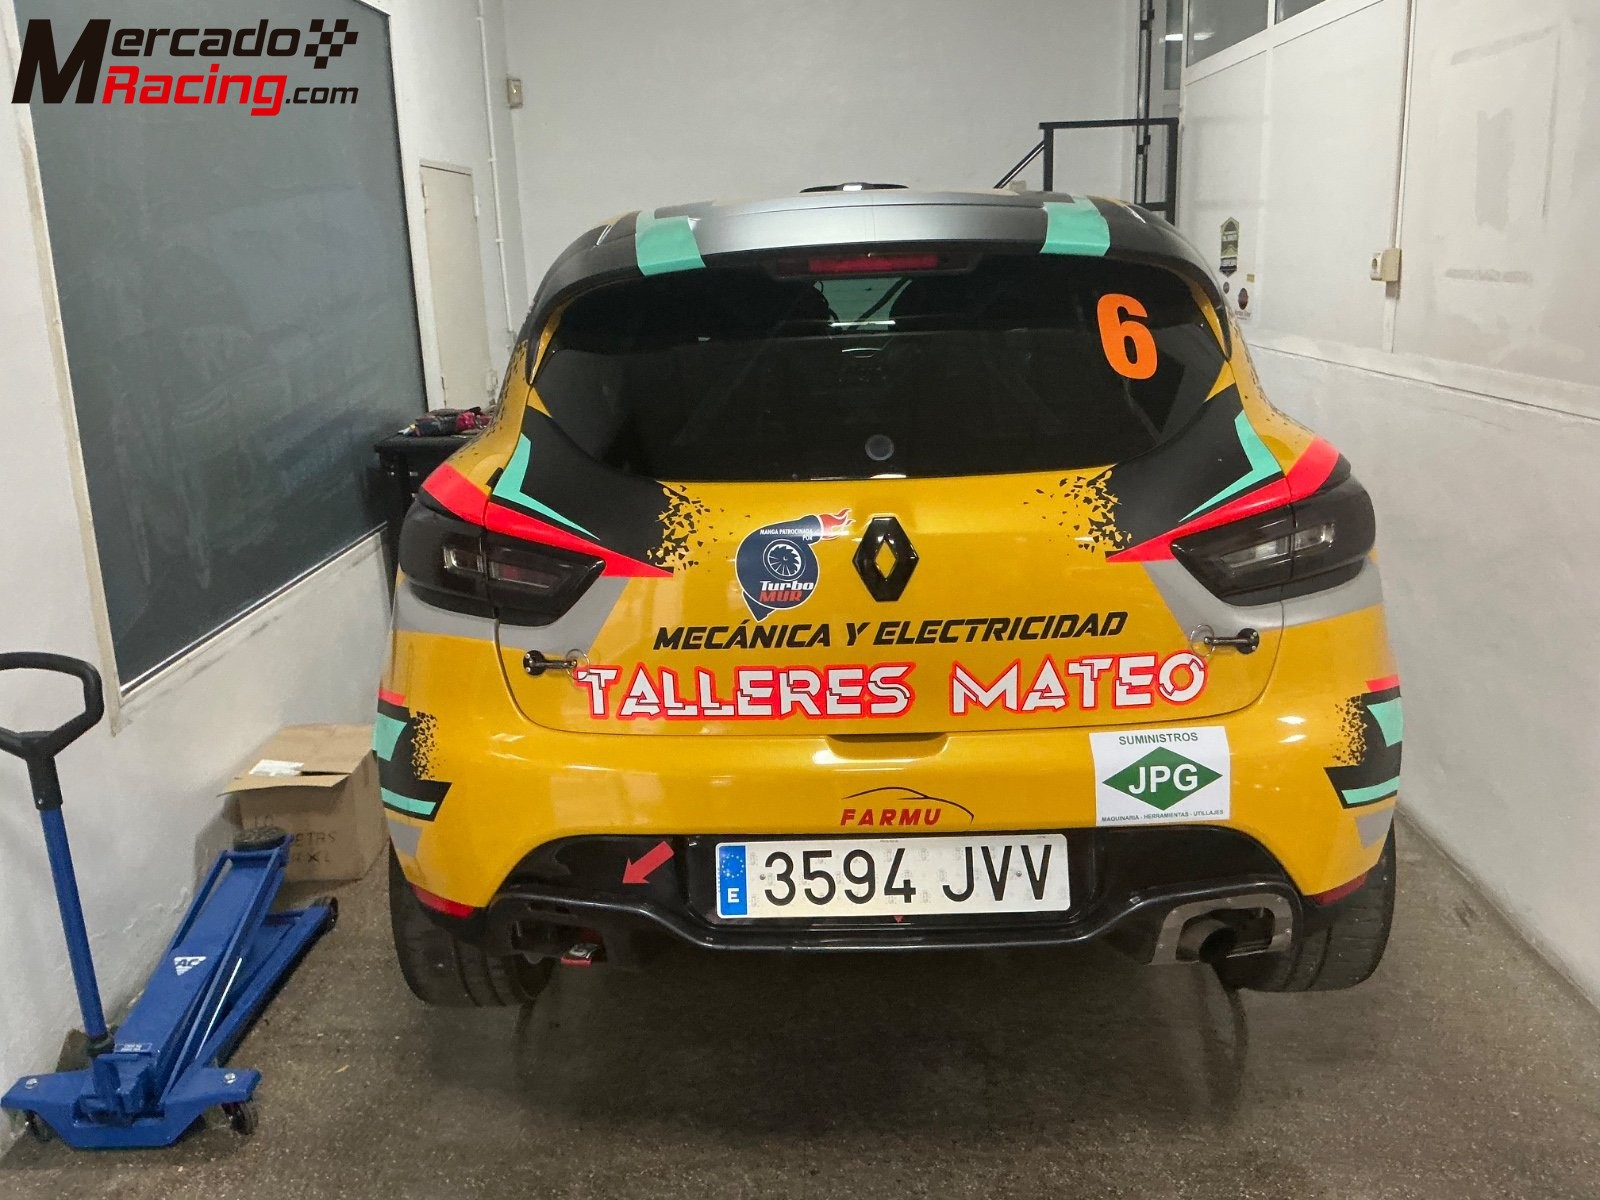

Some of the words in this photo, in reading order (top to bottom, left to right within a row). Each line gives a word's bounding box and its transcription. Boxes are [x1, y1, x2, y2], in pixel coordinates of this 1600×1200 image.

[1097, 293, 1158, 380] 6
[760, 580, 814, 591] Turbo
[759, 591, 803, 602] MUR
[653, 620, 831, 651] MECÁNICA
[846, 622, 871, 646] Y
[873, 611, 1128, 645] ELECTRICIDAD
[575, 662, 917, 721] TALLERES
[950, 650, 1208, 716] MATEO
[1118, 732, 1199, 746] SUMINISTROS
[1128, 763, 1198, 794] JPG
[840, 808, 941, 826] FARMU
[1101, 814, 1139, 822] MAQUINARIA
[1143, 811, 1189, 819] HERRAMIENTAS
[764, 848, 917, 906] 3594
[942, 844, 1052, 902] JVV
[727, 888, 740, 902] E
